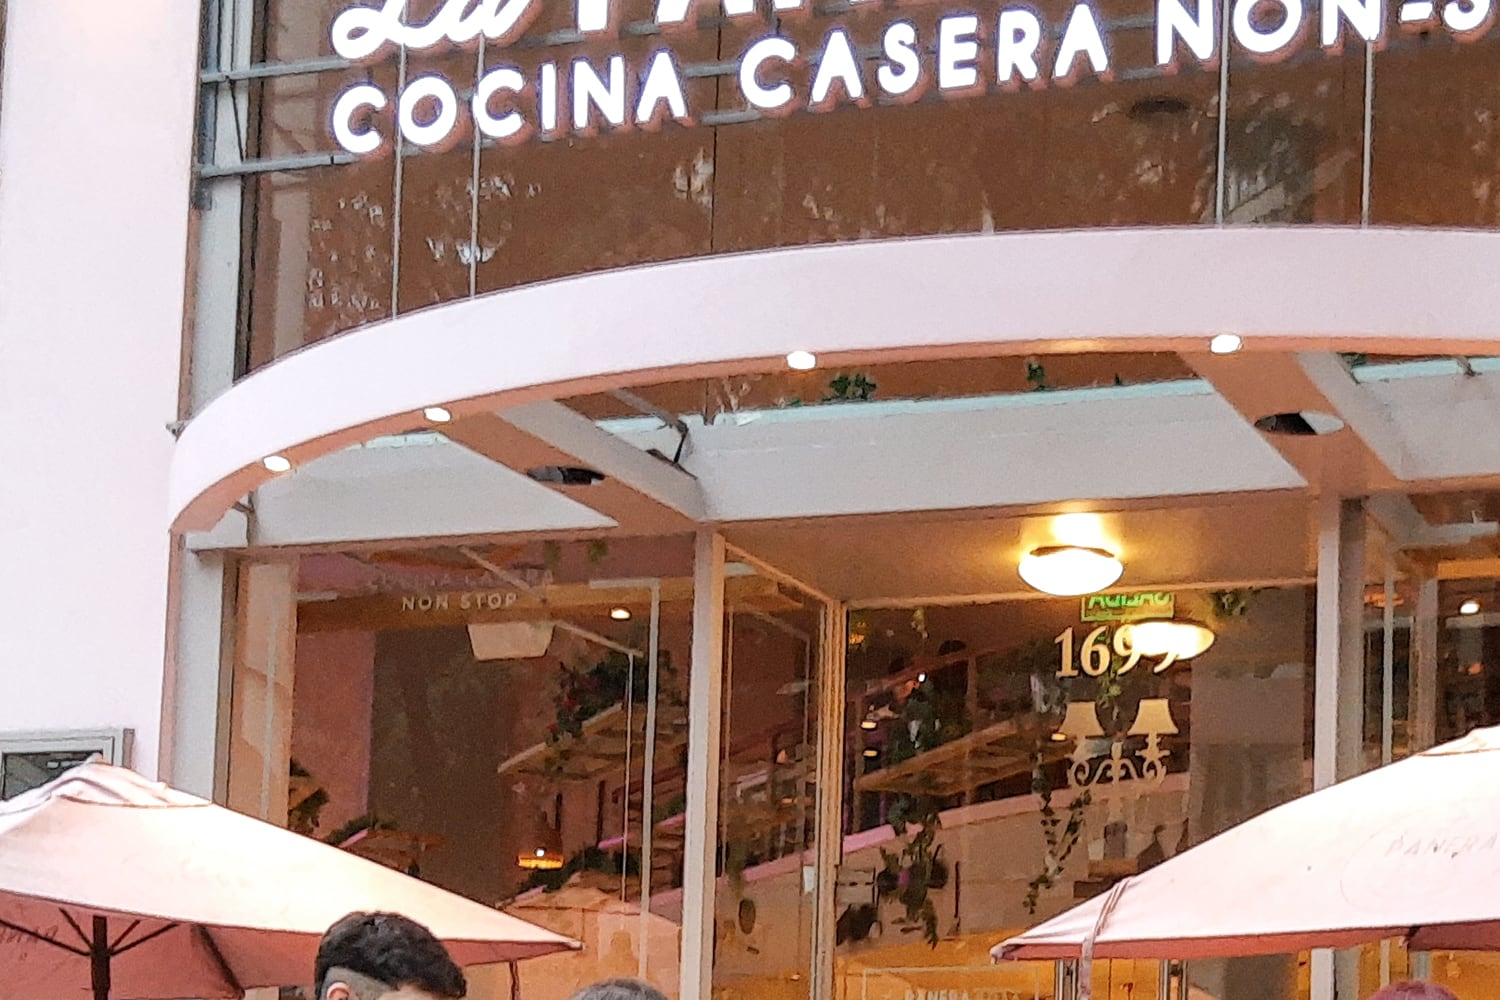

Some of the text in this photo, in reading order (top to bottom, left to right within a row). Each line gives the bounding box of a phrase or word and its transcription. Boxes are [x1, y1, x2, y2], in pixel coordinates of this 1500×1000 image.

[333, 51, 686, 154] COCINA
[739, 3, 1110, 109] CASERA
[401, 591, 518, 611] NON STOP
